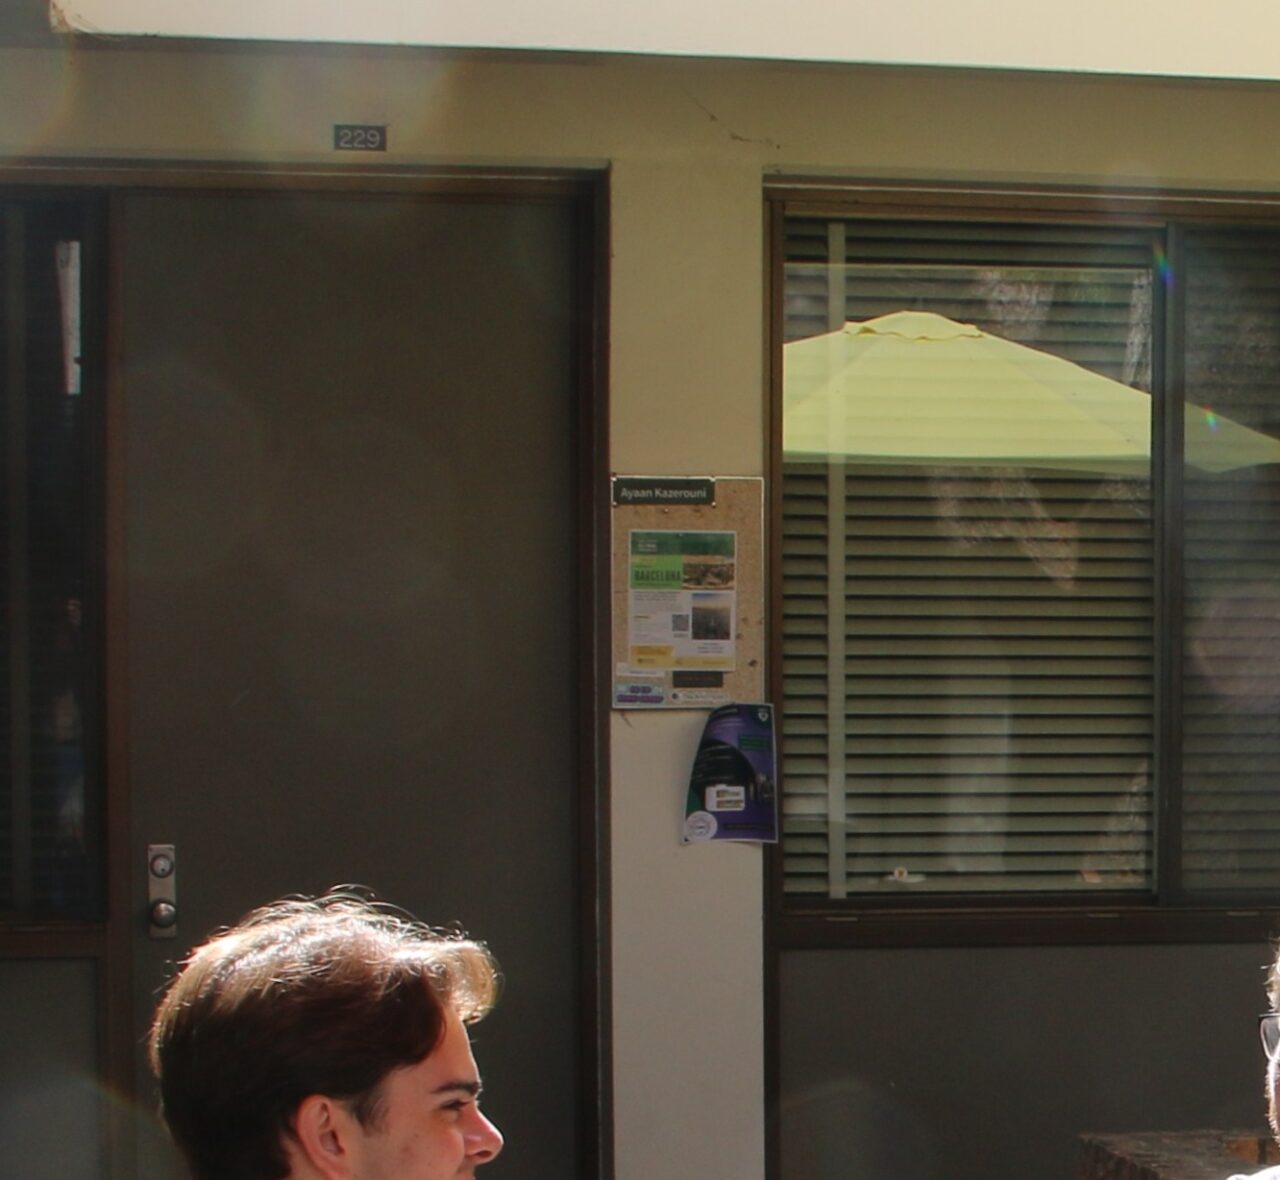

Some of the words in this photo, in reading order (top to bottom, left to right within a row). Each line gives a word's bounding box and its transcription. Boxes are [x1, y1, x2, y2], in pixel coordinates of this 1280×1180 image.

[339, 129, 381, 148] 229
[620, 487, 653, 499] Ayaan
[654, 487, 707, 498] Kazerouni
